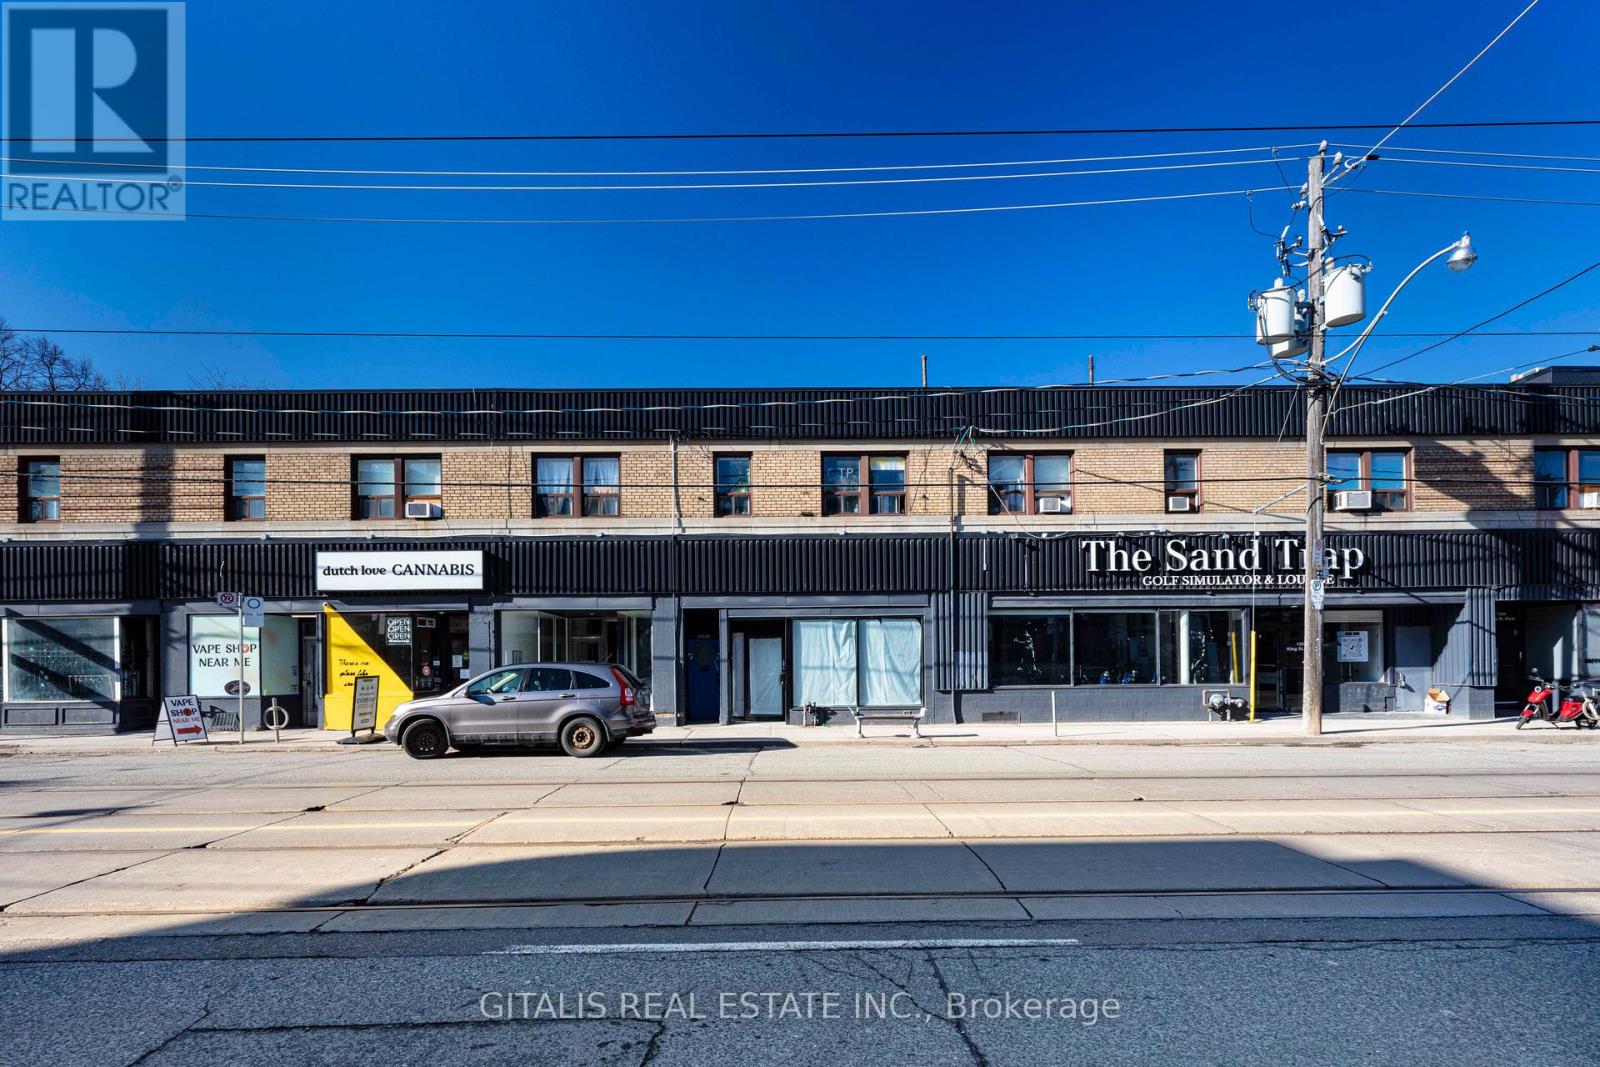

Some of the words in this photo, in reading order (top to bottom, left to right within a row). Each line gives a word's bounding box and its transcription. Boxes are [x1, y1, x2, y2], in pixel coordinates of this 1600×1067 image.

[1081, 540, 1152, 572] The
[1166, 539, 1262, 571] Sand
[322, 565, 359, 576] dutch
[361, 565, 387, 576] love
[391, 563, 475, 577] CANNABIS
[1142, 575, 1179, 586] GOLF
[1181, 575, 1262, 586] SIMULATOR
[1264, 575, 1274, 585] &
[1276, 574, 1335, 585] LOUE
[387, 618, 410, 626] OPEN
[387, 625, 410, 633] OPEN
[387, 632, 410, 640] OPEN
[192, 644, 221, 654] VAPE
[225, 643, 257, 654] SHOP
[199, 657, 229, 667] NEAR
[234, 657, 251, 667] ME
[170, 698, 194, 707] VAPE
[170, 707, 198, 717] SHOP
